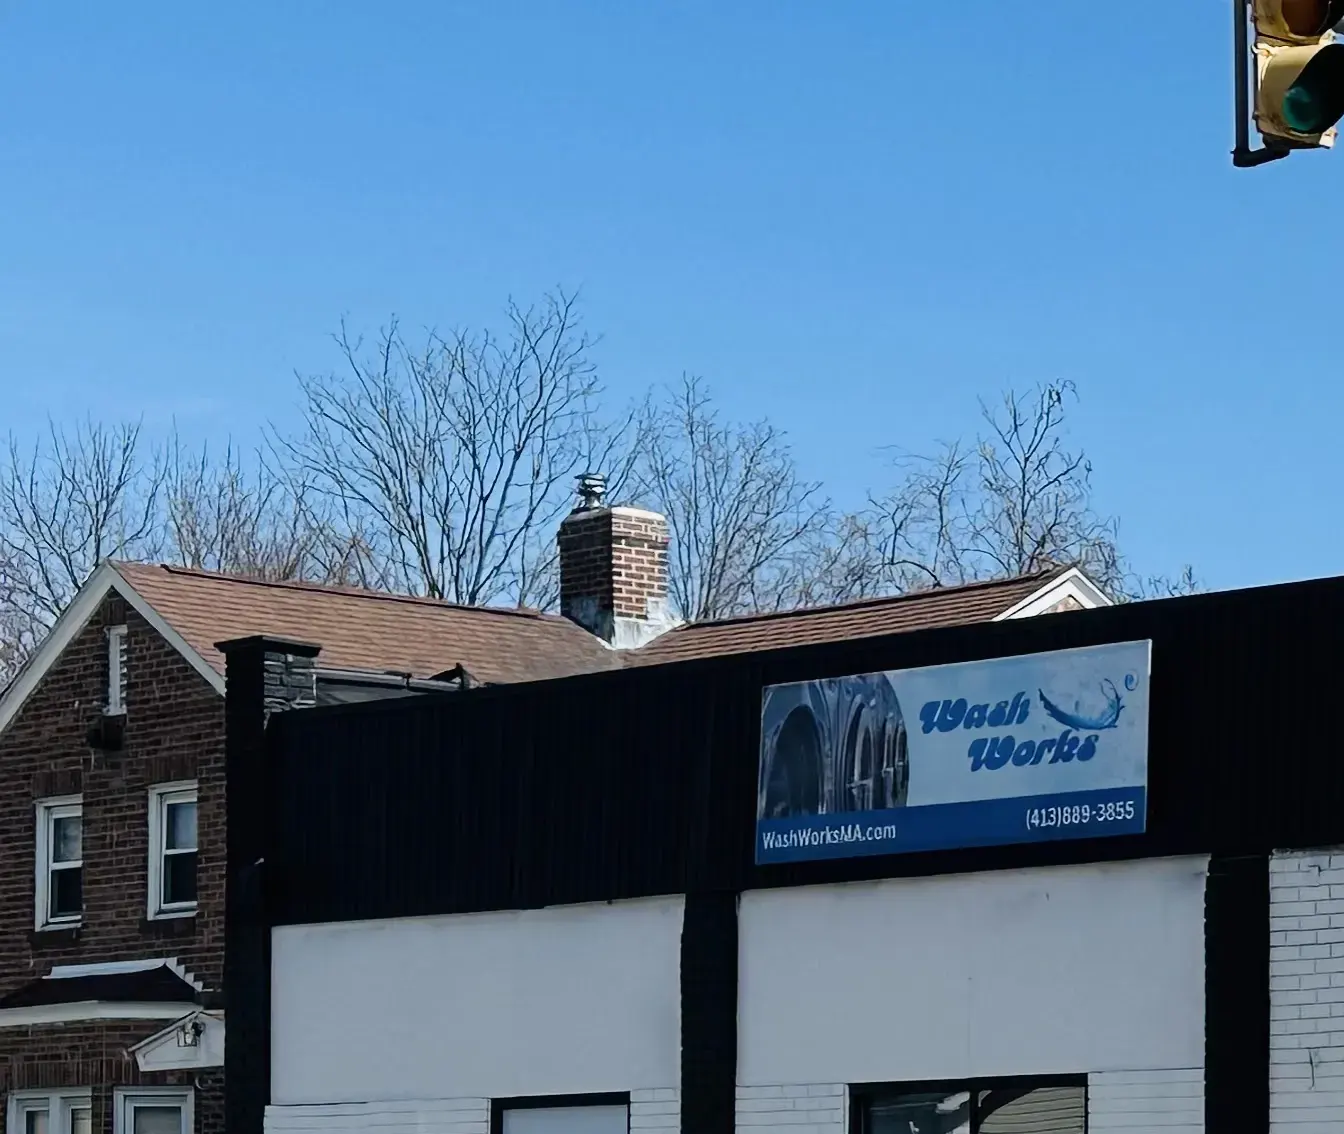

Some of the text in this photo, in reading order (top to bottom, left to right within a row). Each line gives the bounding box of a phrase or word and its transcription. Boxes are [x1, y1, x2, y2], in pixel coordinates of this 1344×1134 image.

[919, 691, 1030, 734] Wash
[968, 730, 1099, 772] Works
[1026, 801, 1135, 830] (413)889-3855
[762, 823, 896, 850] WashWorksMA.com
